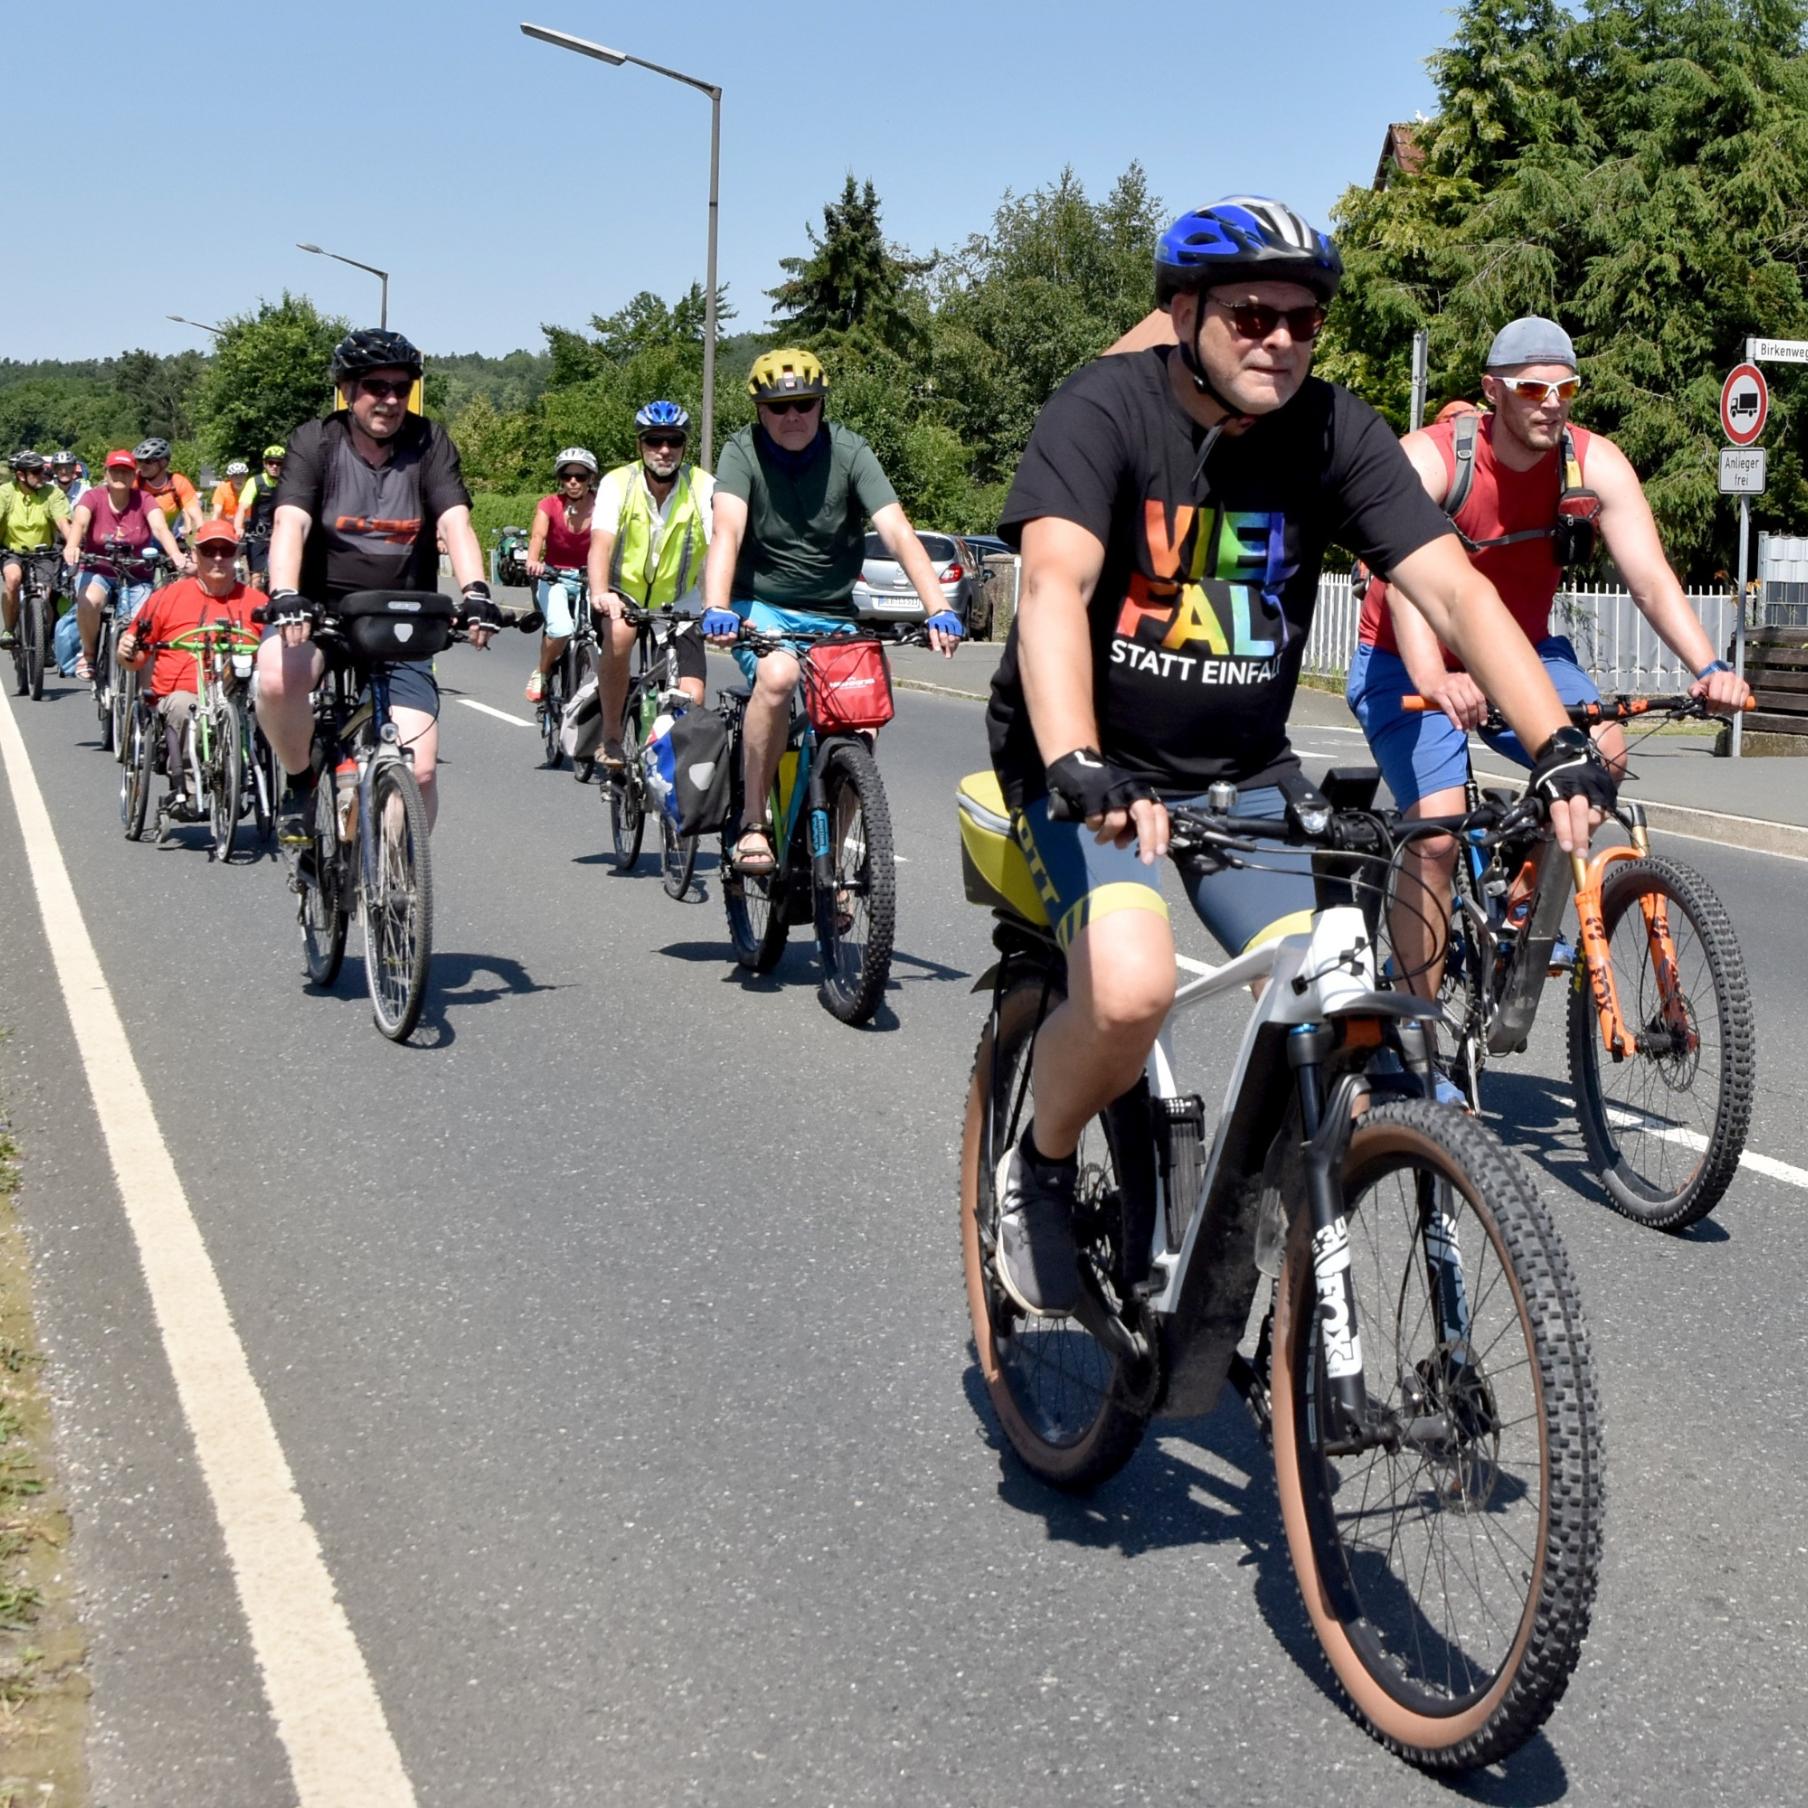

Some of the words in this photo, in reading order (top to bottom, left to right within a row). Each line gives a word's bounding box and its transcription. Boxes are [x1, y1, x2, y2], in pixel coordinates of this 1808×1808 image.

[1761, 343, 1808, 361] Birkenweg
[1725, 456, 1759, 472] Anlieger
[1734, 473, 1749, 486] frei
[1110, 640, 1196, 681] STATT
[1316, 1271, 1354, 1365] FOX
